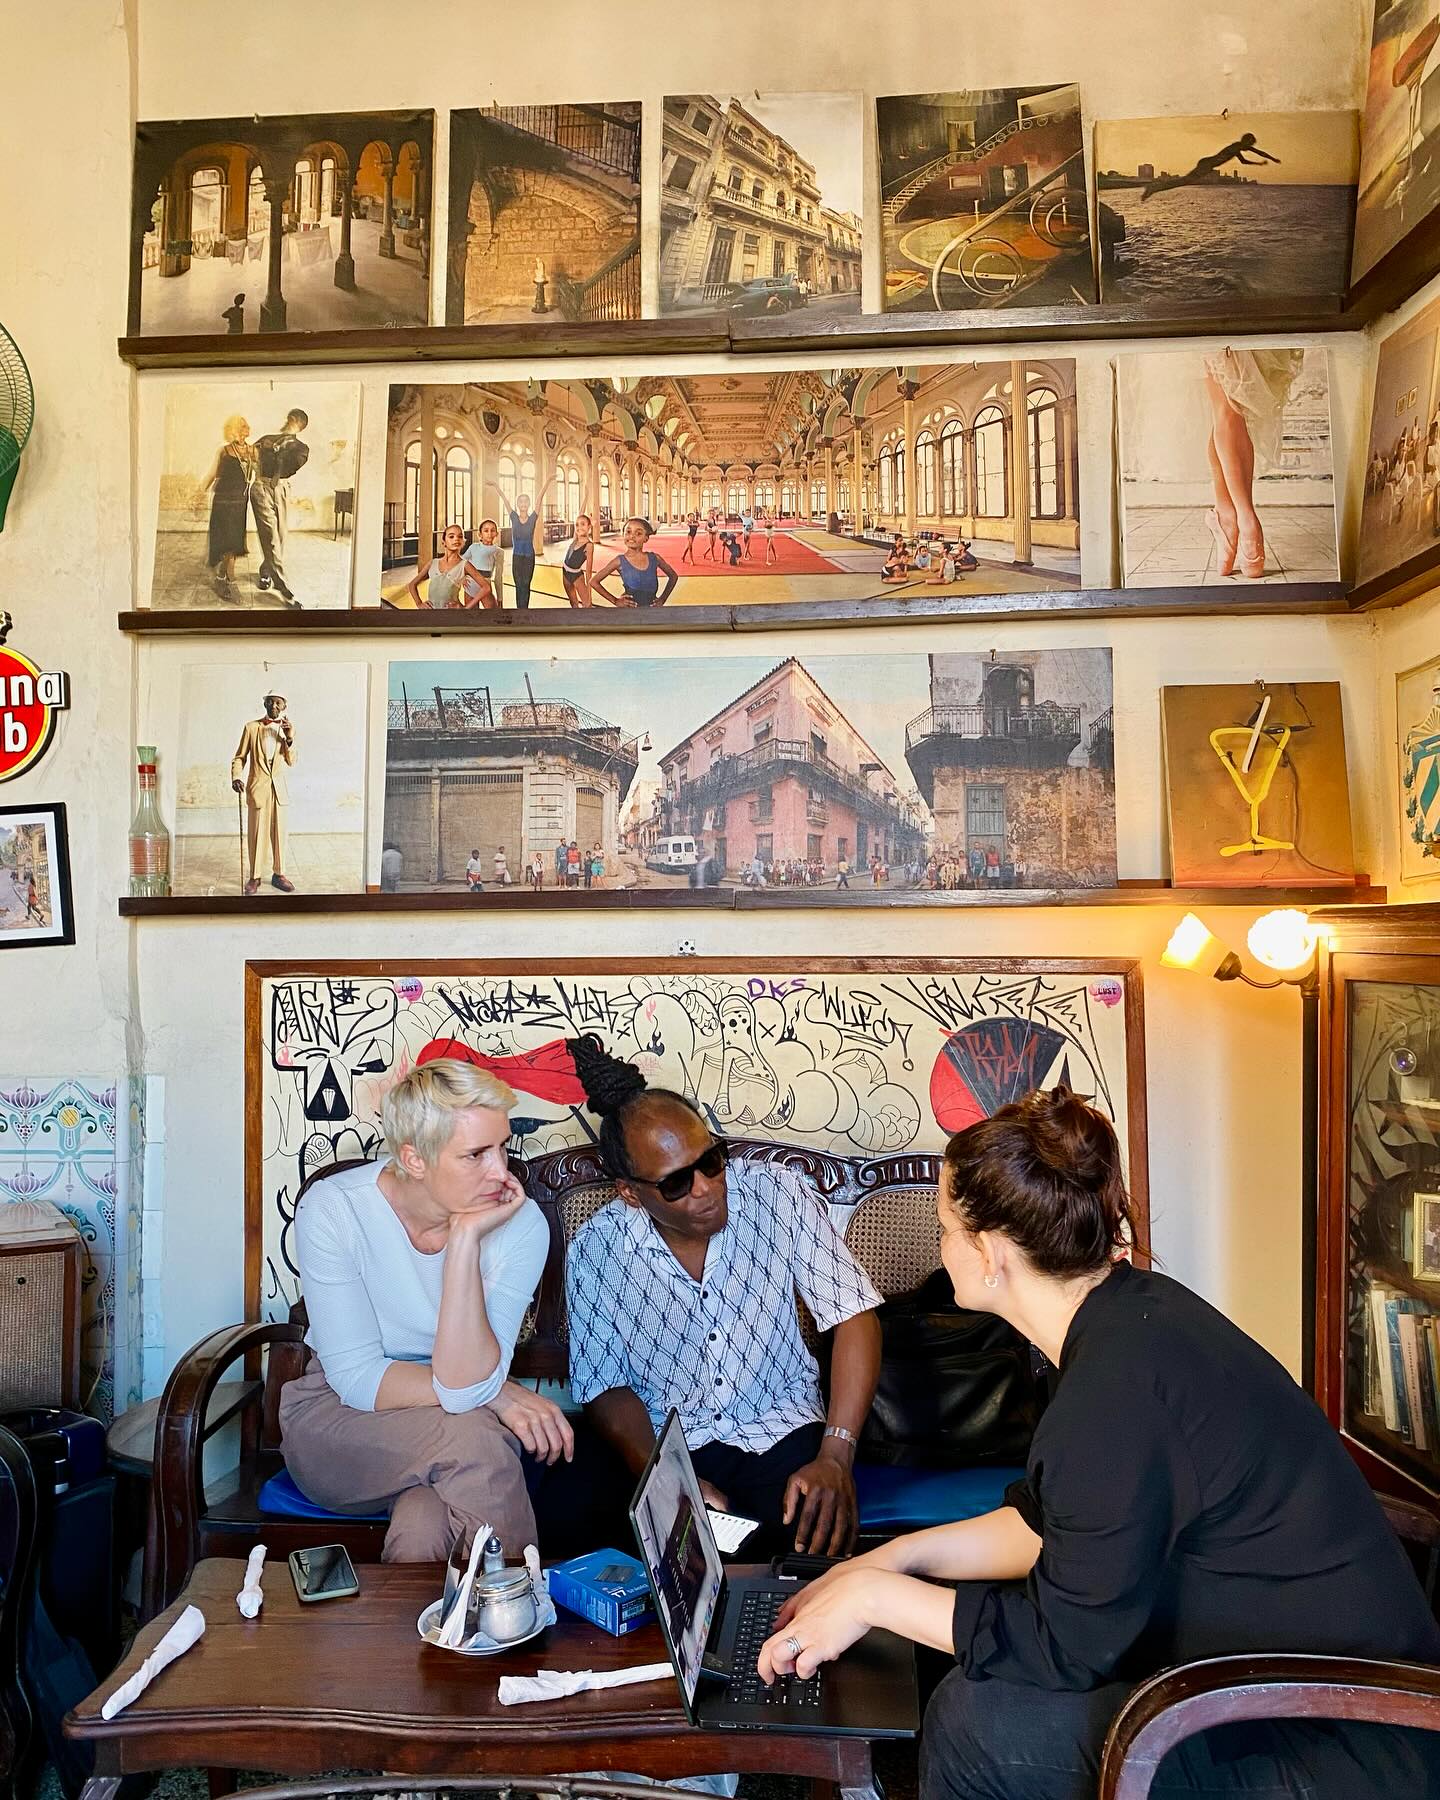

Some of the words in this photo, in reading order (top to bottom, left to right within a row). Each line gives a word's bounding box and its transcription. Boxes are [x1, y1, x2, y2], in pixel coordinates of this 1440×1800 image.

[401, 984, 418, 992] LUST
[747, 978, 807, 998] DKS
[1097, 987, 1116, 995] LUST
